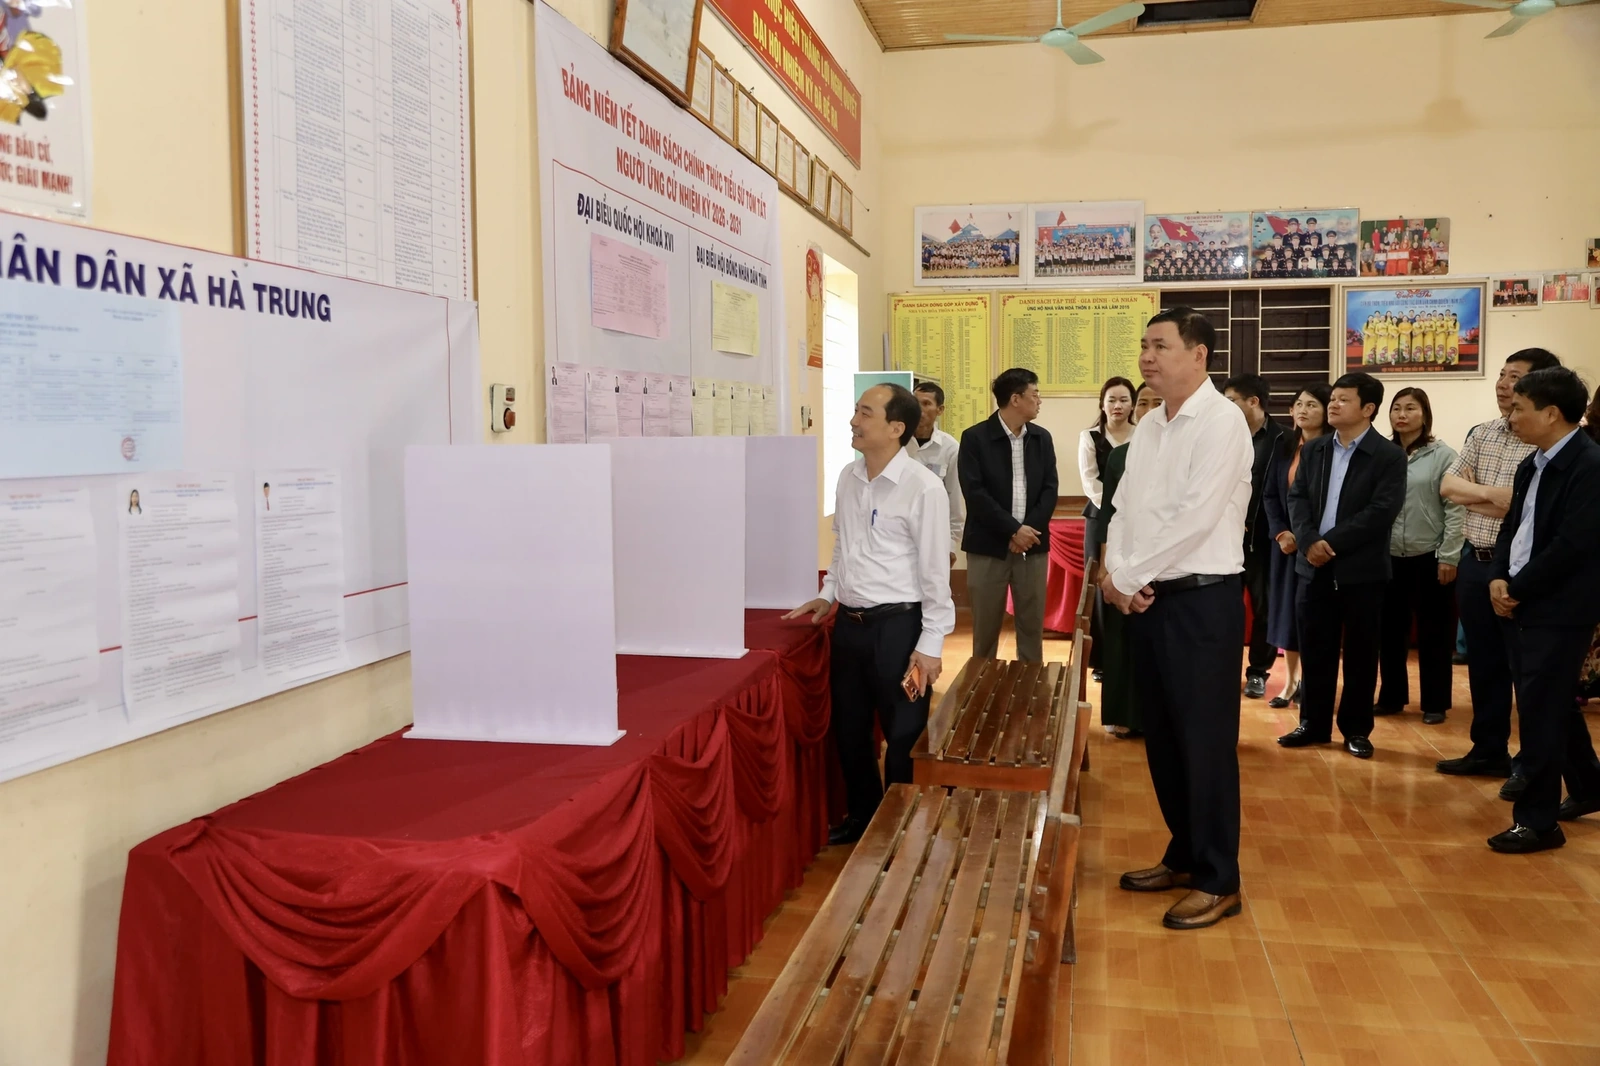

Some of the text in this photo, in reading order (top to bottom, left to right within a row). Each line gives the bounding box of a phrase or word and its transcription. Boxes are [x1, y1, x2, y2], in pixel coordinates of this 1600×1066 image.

[752, 10, 767, 51] ĐẠI
[768, 29, 781, 68] HỘI
[783, 46, 805, 92] NHIỆM
[805, 74, 813, 103] KỲ
[831, 105, 838, 132] RA
[784, 5, 800, 47] HIỆN
[801, 28, 820, 73] THẮNG
[561, 62, 591, 113] BẢNG
[593, 89, 618, 129] NIÊM
[620, 103, 637, 140] YẾT
[639, 119, 661, 156] DANH
[663, 133, 682, 169] SÁCH
[684, 149, 705, 182] CHÍNH
[706, 164, 723, 193] THỨC
[724, 170, 736, 202] TIỂU
[737, 179, 745, 206] SỬ
[746, 188, 757, 214] TÓM
[577, 193, 674, 252] ĐẠI BIỂU QUỐC HỘI KHOÁ XVI
[616, 146, 645, 186] NGƯỜI
[648, 159, 664, 196] ỨNG
[667, 170, 677, 202] CỬ
[679, 184, 700, 218] NHIỆM
[702, 193, 711, 220] KỲ
[712, 203, 725, 228] 2026
[730, 212, 741, 236] 2031
[0, 232, 332, 322] ÂN DÂN XÃ HÀ TRUNG
[697, 245, 705, 269] ĐẠI
[706, 243, 716, 270] BIỂU
[717, 252, 725, 277] HỘI
[726, 253, 737, 278] ĐỒNG
[1065, 296, 1076, 304] THỂ
